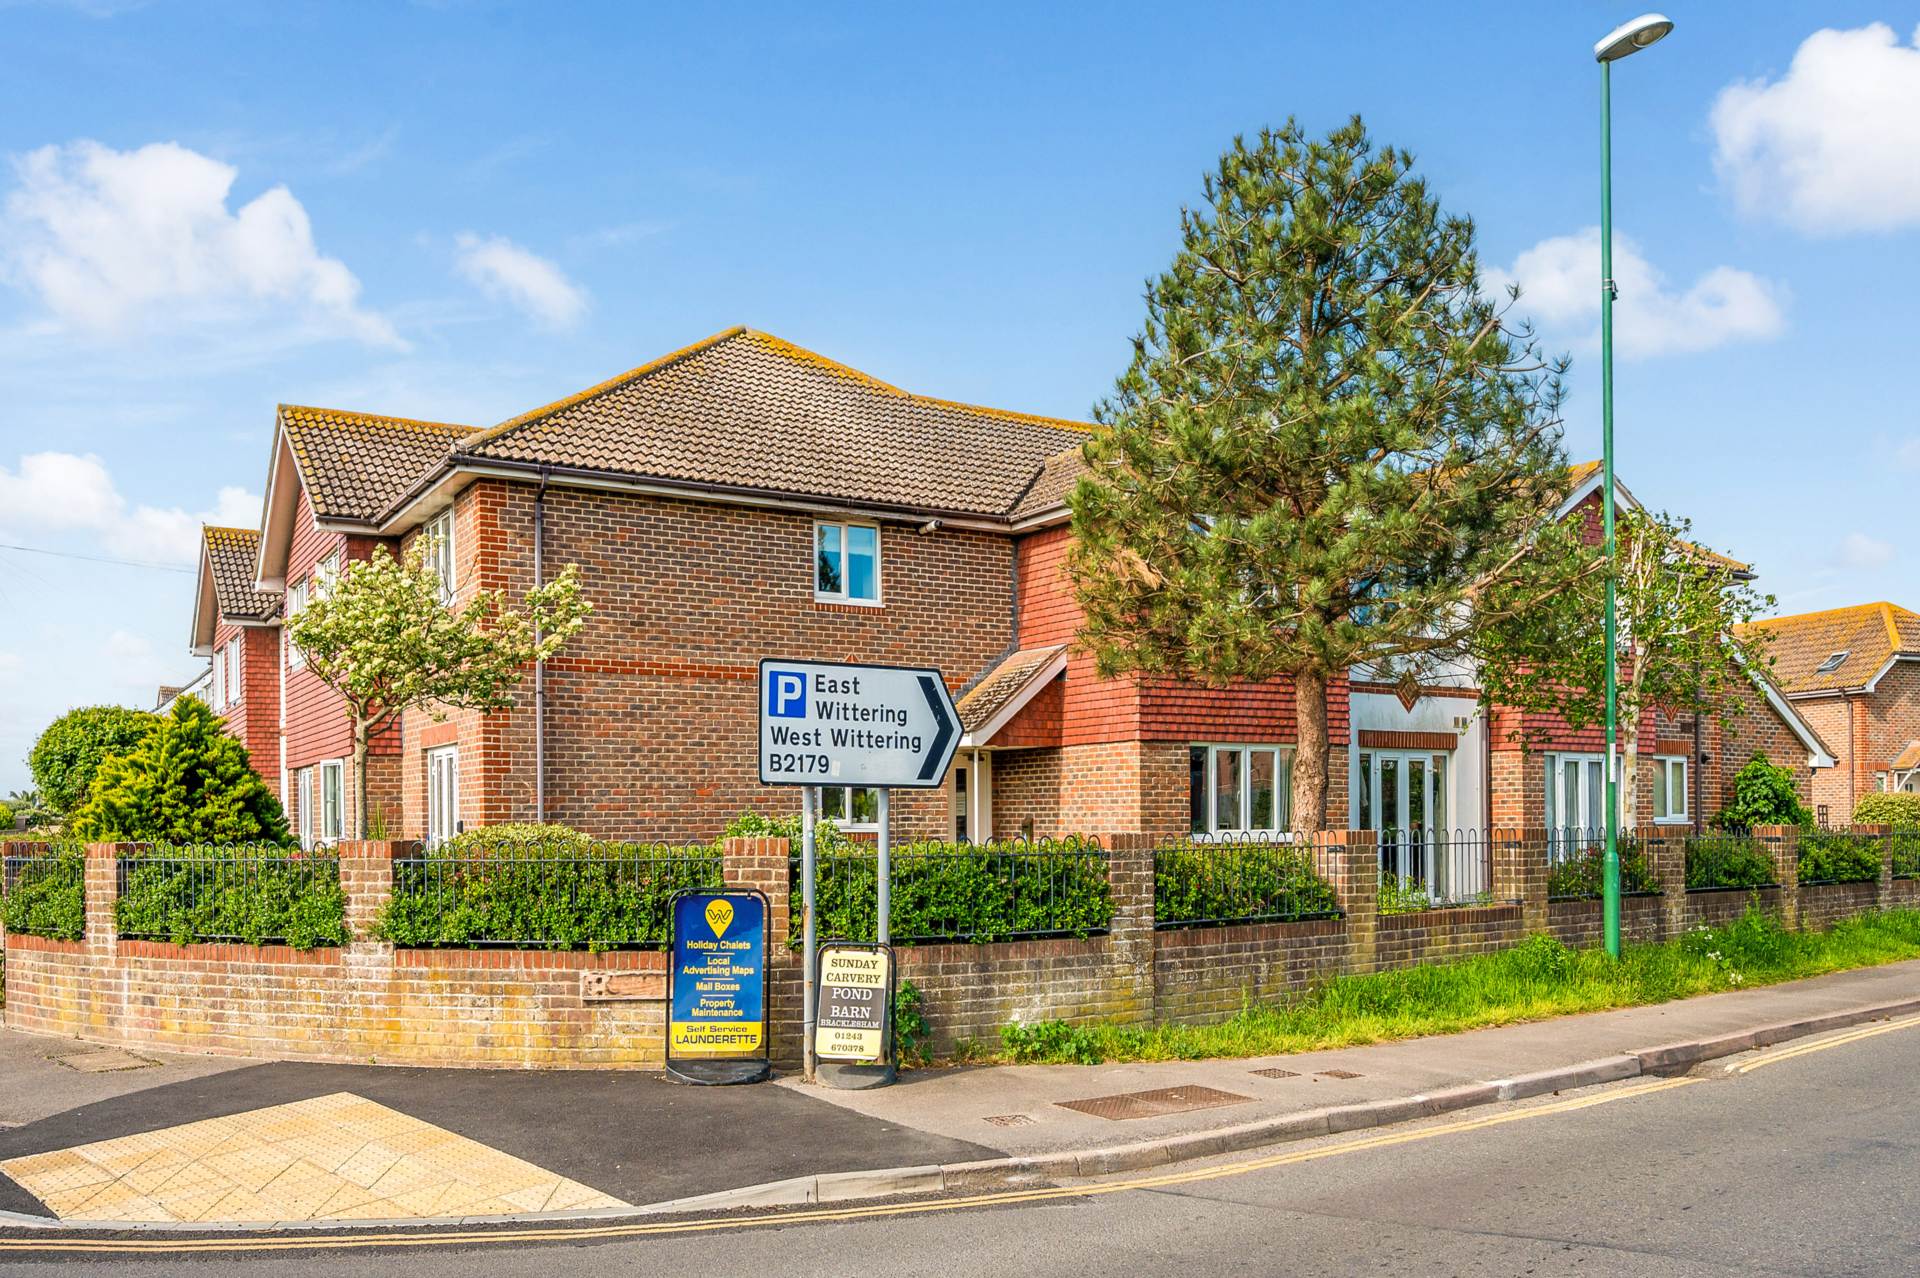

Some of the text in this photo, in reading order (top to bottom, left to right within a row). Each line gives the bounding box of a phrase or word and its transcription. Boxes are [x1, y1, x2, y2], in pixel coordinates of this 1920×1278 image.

[815, 674, 860, 695] East
[777, 675, 802, 714] P
[816, 701, 908, 727] Wittering
[771, 726, 922, 753] West Wittering
[770, 753, 830, 774] B2179
[687, 940, 751, 951] Holiday Chalets
[707, 956, 730, 965] Local
[831, 958, 879, 969] SUNDAY
[683, 966, 754, 976] Advertising Maps
[826, 972, 882, 984] CARVERY
[696, 982, 741, 991] Mail Boxes
[831, 987, 873, 1000] POND
[700, 999, 735, 1009] Property
[691, 1008, 744, 1017] Maintenance
[830, 1005, 872, 1019] BARN
[686, 1025, 748, 1033] Self Service
[820, 1019, 880, 1029] BRACKLESHAM
[675, 1034, 757, 1044] LAUNDERETTE
[834, 1032, 863, 1040] 01243
[831, 1044, 865, 1052] 670378
